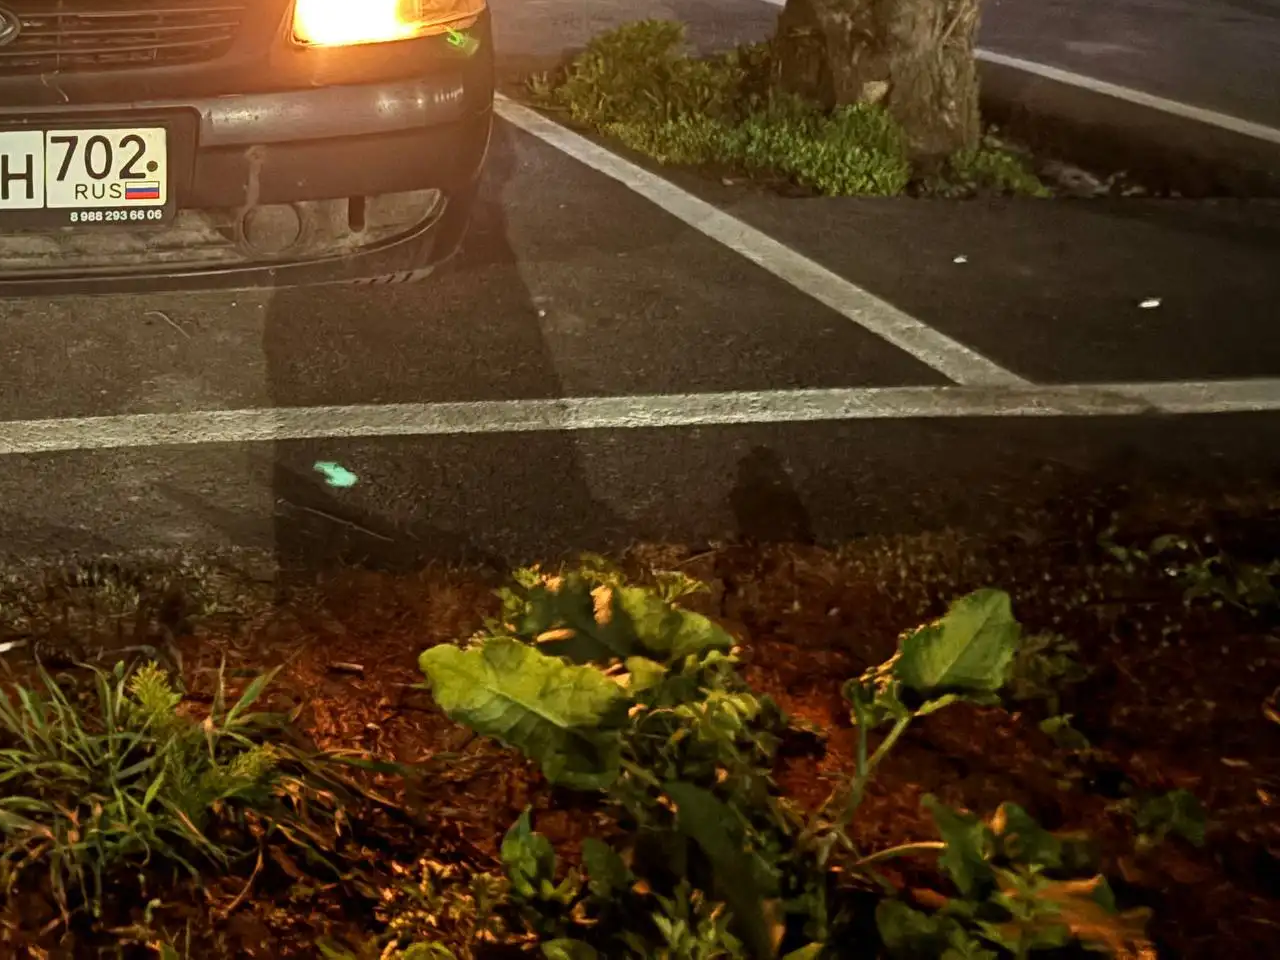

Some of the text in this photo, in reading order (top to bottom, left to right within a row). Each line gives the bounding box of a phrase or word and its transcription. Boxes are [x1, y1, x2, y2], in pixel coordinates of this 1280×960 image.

[50, 134, 147, 182] 702
[74, 183, 122, 200] RUS
[70, 209, 163, 222] 8 988 293 66 06
